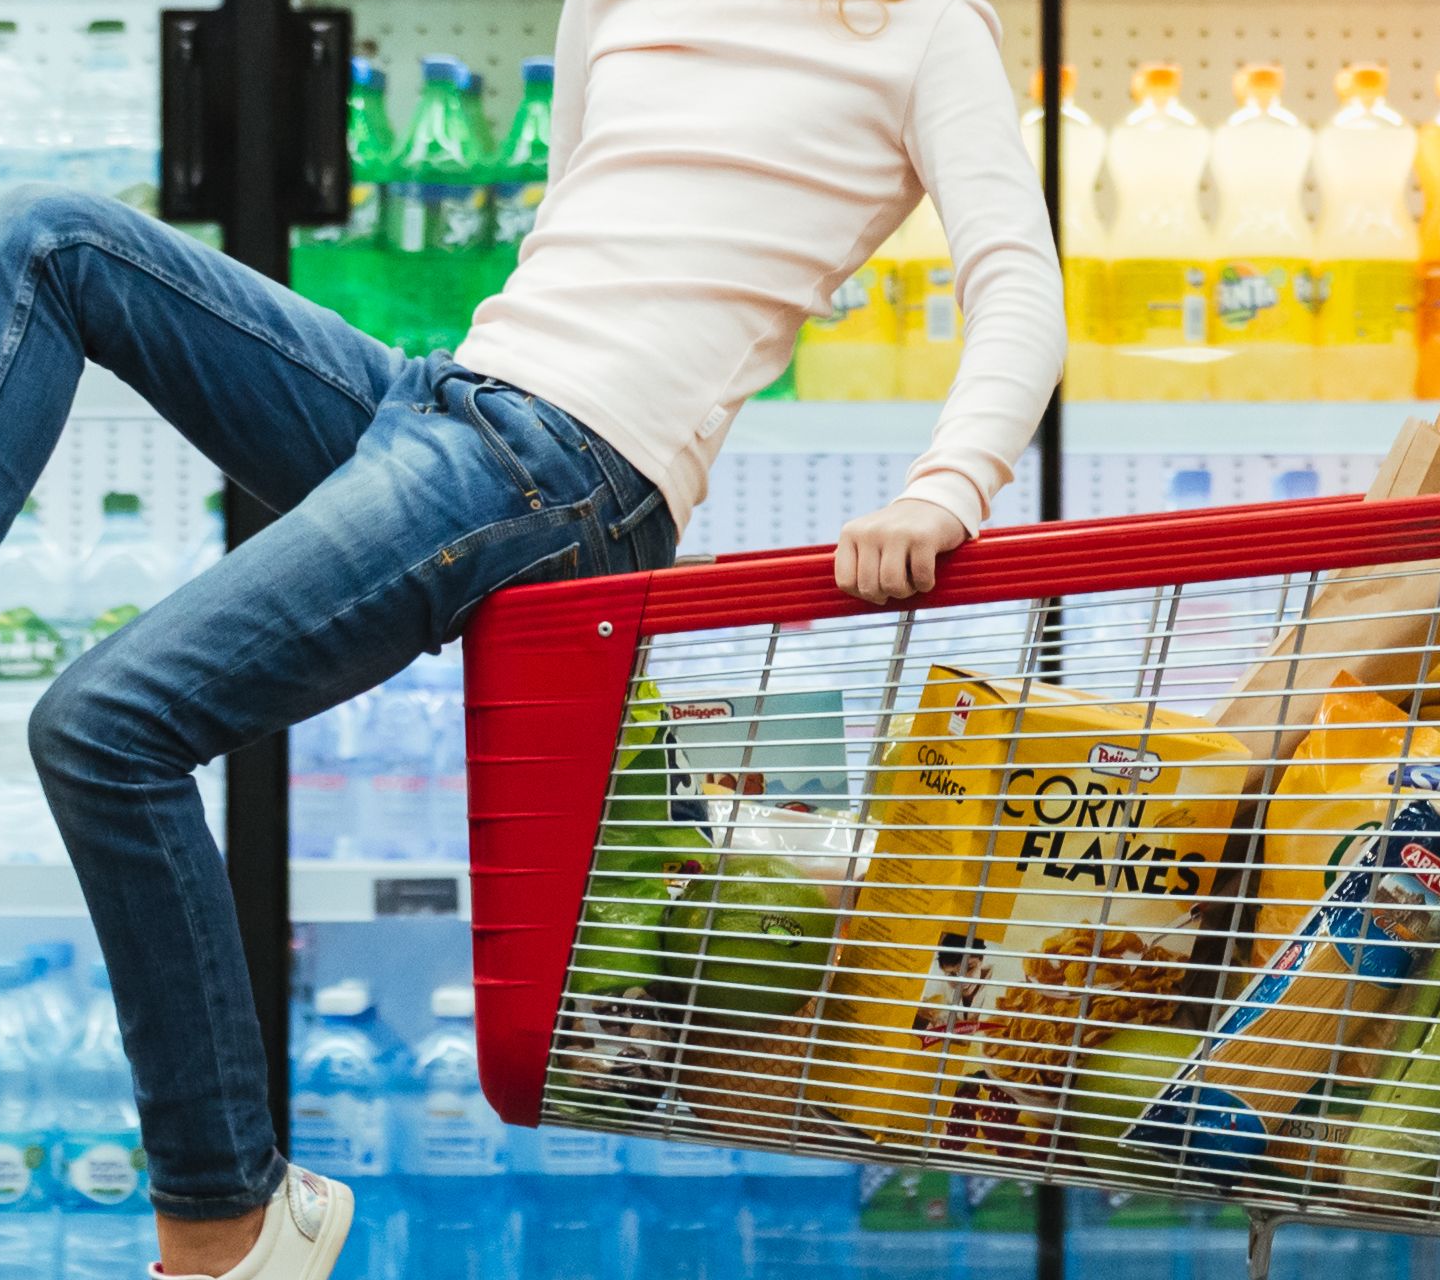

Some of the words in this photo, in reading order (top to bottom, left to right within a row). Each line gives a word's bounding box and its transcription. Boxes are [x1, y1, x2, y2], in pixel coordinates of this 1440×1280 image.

[671, 703, 728, 719] Brüggen
[917, 744, 954, 775] CORN
[920, 772, 967, 804] FLAKES
[1002, 769, 1149, 839] CORN
[1015, 824, 1207, 897] FLAKES
